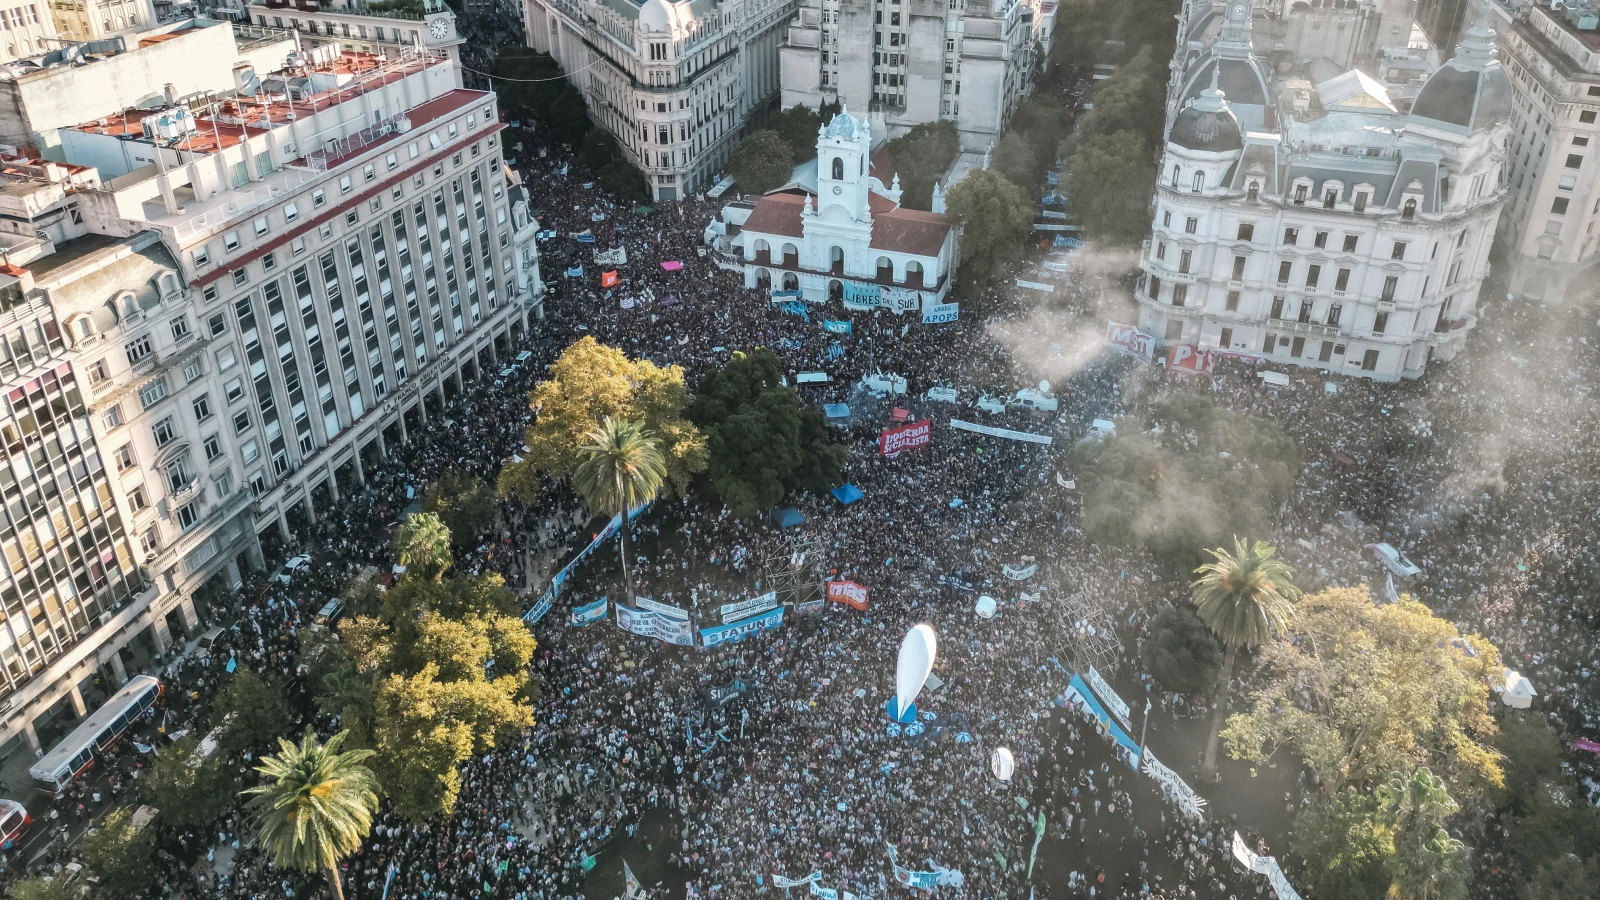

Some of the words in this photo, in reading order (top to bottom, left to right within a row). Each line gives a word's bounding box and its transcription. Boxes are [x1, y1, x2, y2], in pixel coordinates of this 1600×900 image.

[845, 289, 880, 305] LIBRES
[882, 297, 894, 307] DEL
[897, 298, 915, 310] SUR
[924, 311, 957, 322] APOPS
[383, 403, 391, 412] LA
[394, 382, 417, 403] FRANCO
[420, 355, 451, 382] ARGENTINA
[829, 583, 866, 603] mas
[721, 620, 766, 639] FATUN
